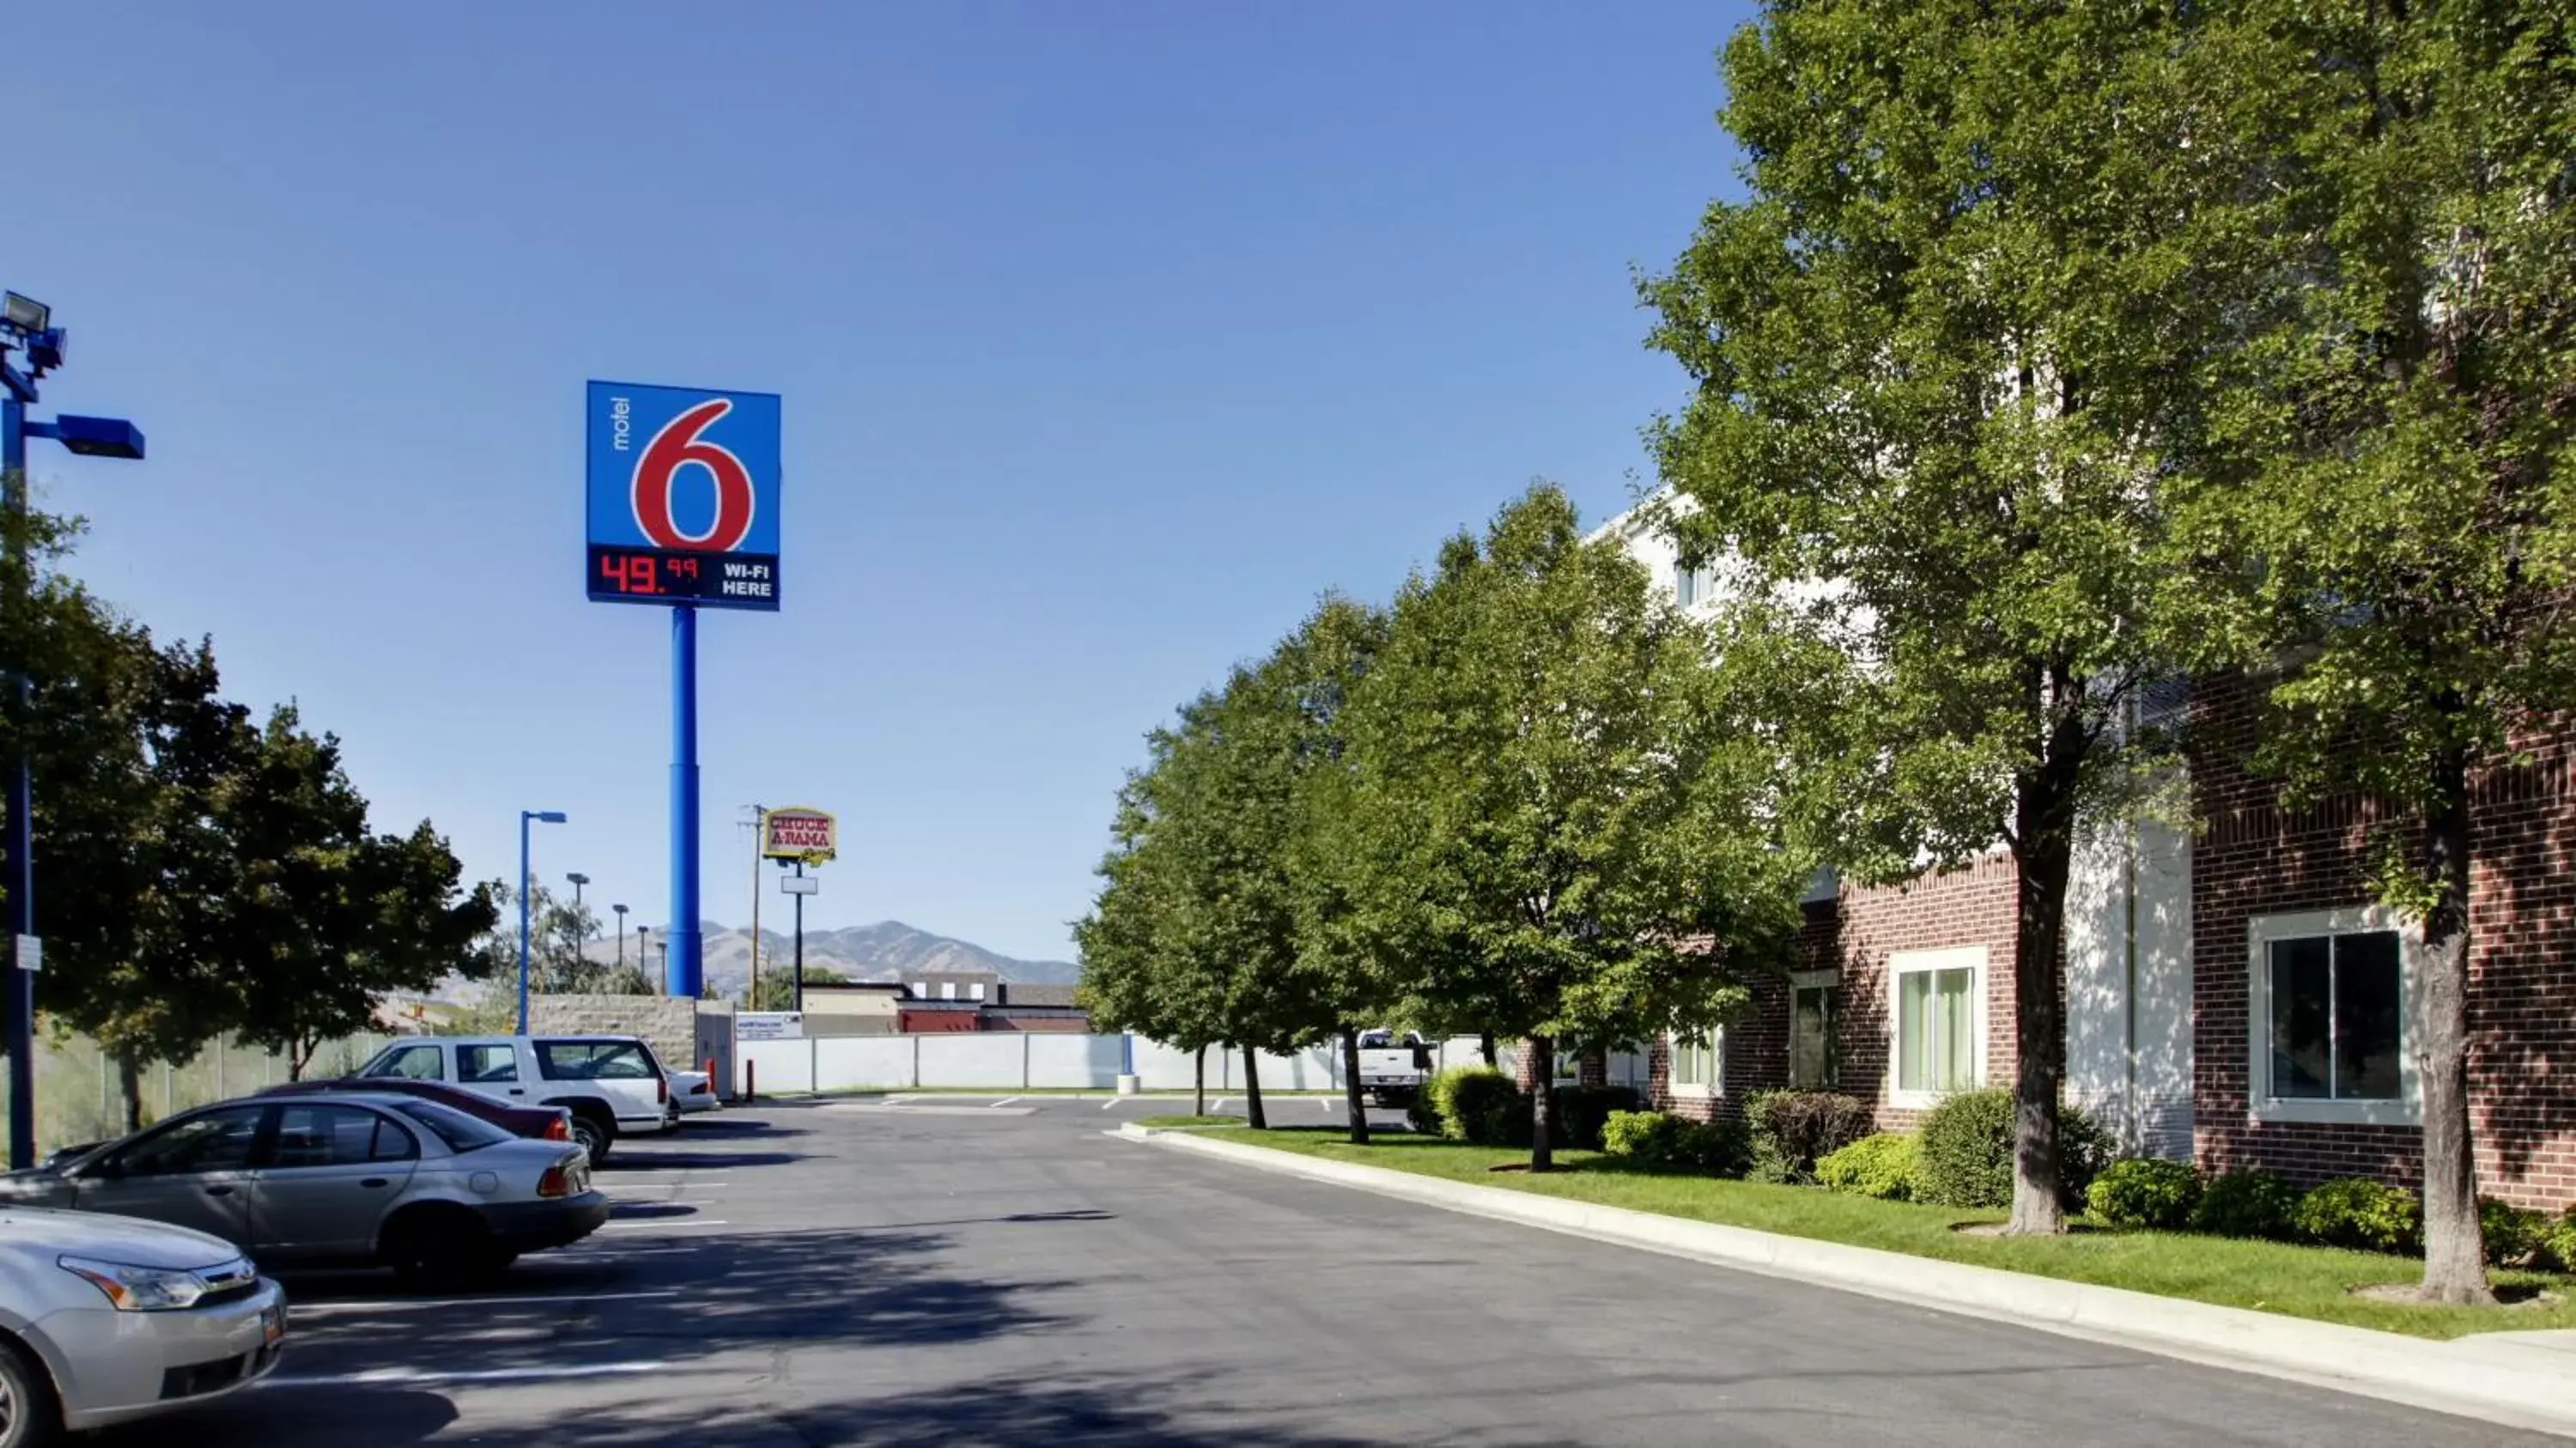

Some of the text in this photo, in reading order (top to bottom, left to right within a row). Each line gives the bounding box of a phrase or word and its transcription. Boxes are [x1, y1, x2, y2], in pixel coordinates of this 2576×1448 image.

[611, 398, 630, 451] motel
[630, 398, 756, 552] 6
[724, 563, 769, 580] WI-FI
[723, 581, 772, 597] HERE
[770, 817, 829, 831] CHUCK
